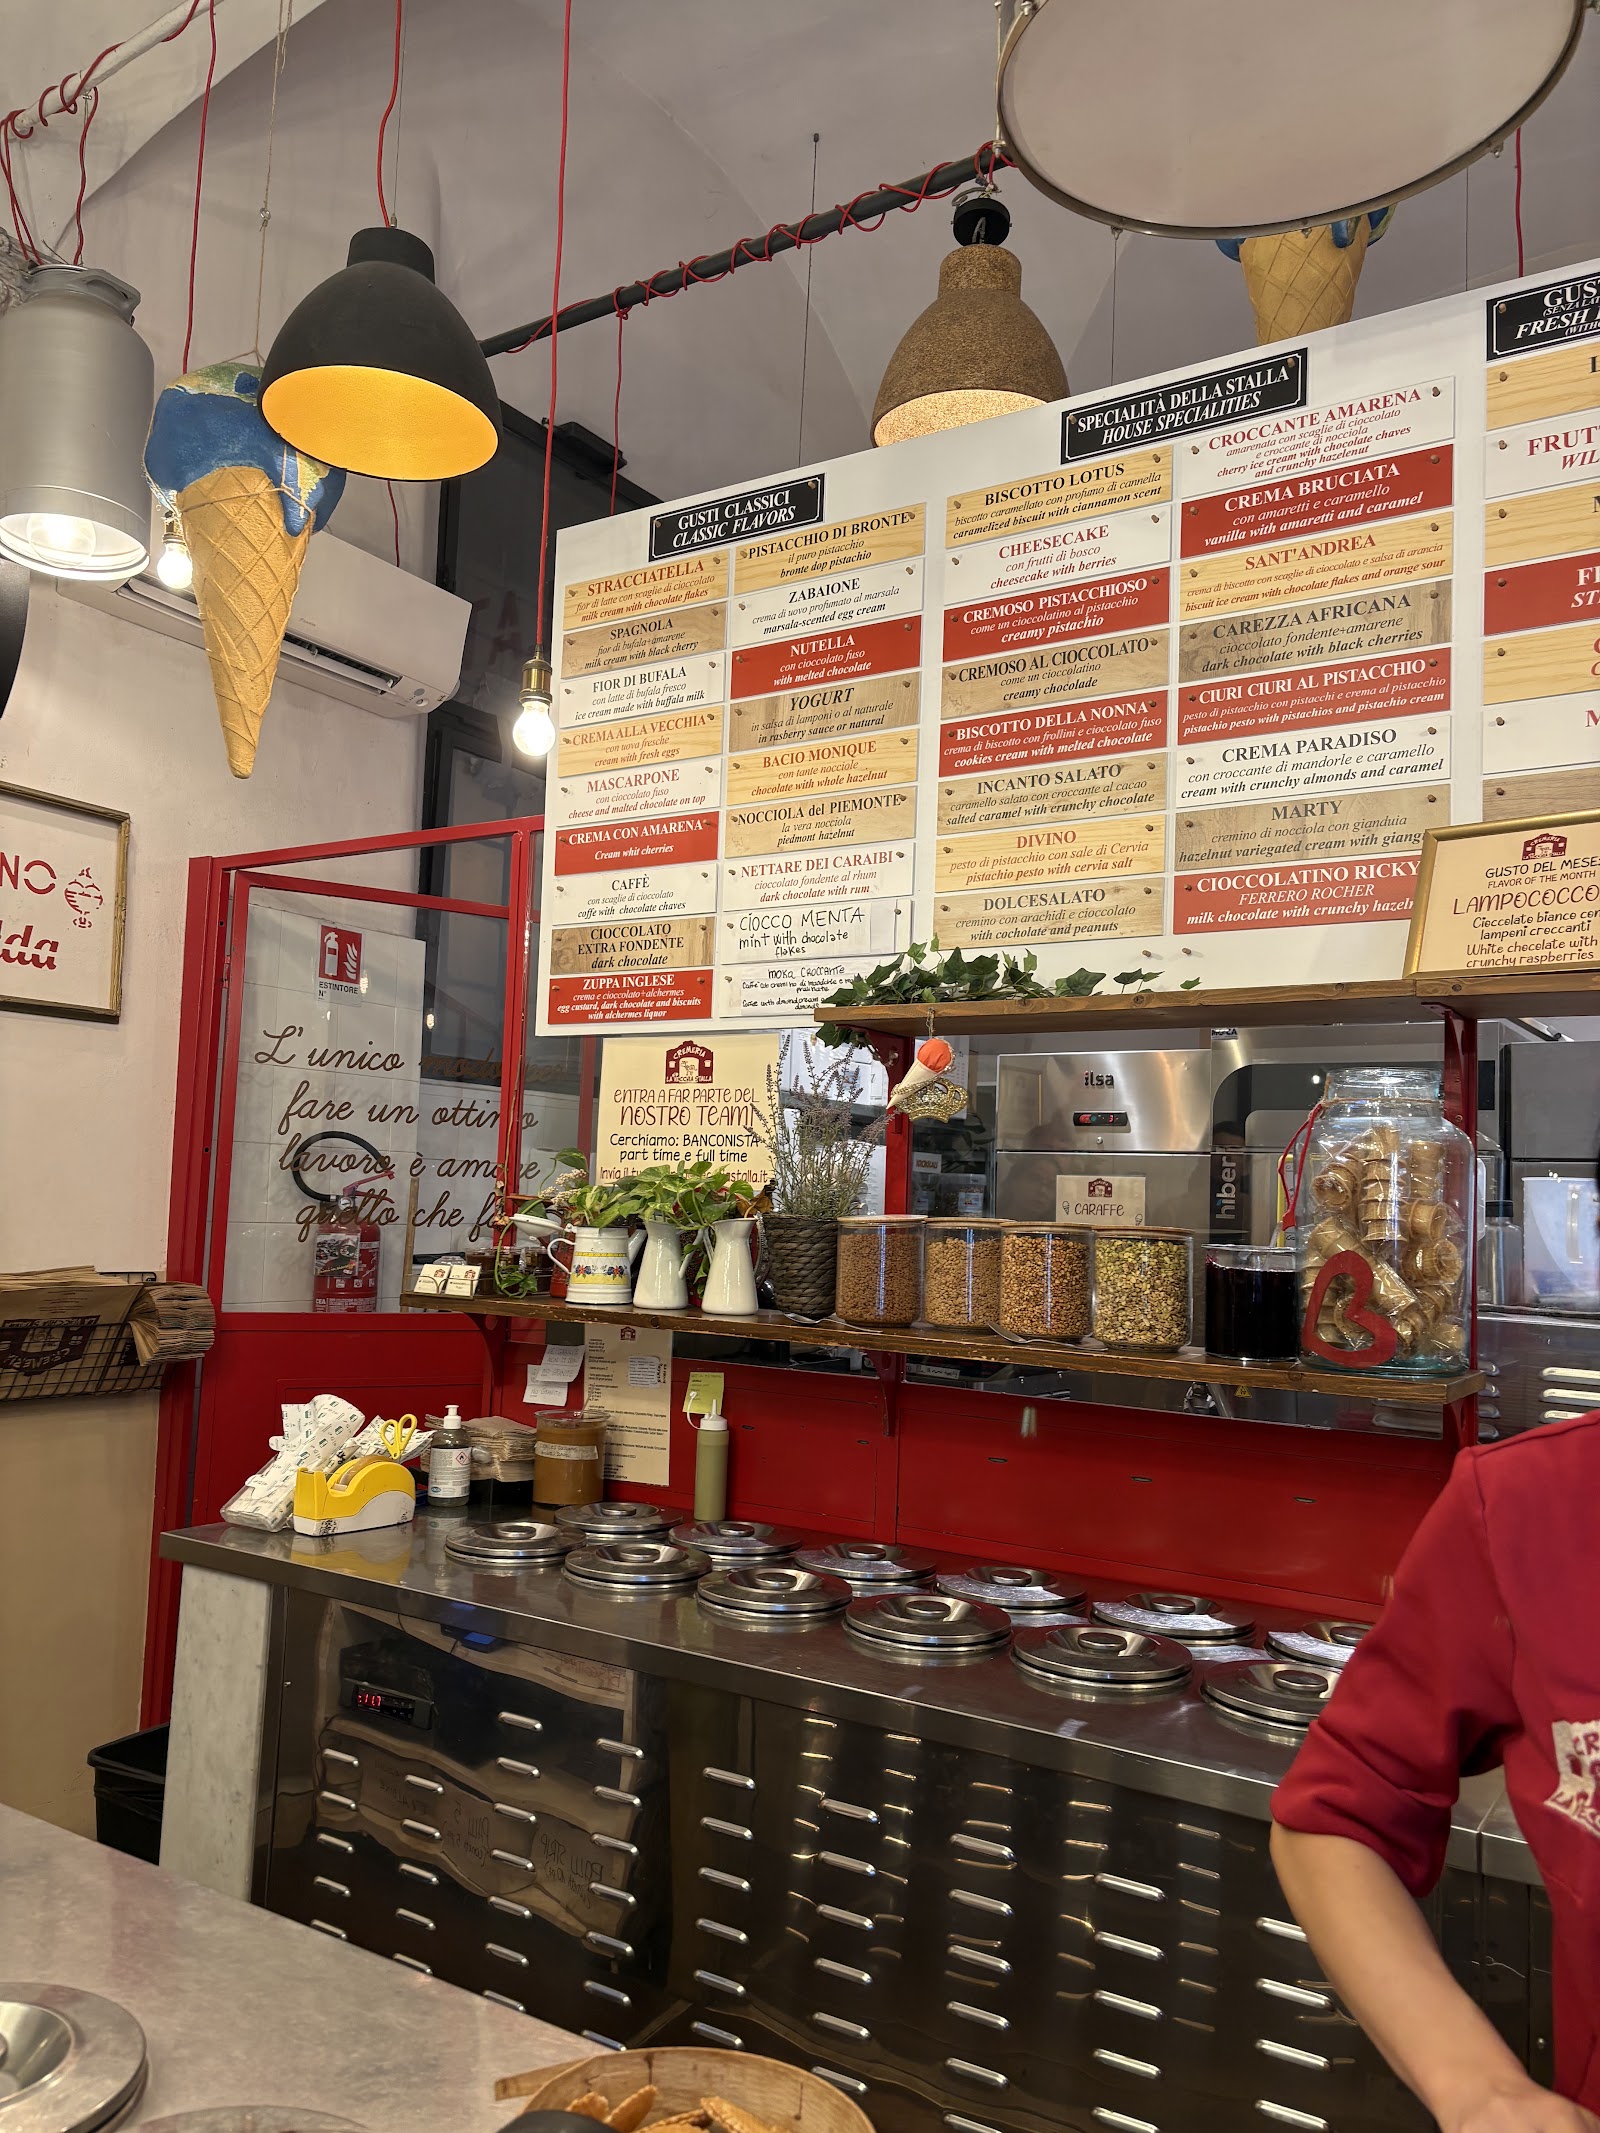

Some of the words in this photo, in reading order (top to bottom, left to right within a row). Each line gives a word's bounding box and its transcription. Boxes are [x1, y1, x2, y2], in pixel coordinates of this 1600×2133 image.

[1543, 280, 1600, 308] GUS
[1514, 308, 1591, 340] FRESH
[1565, 320, 1600, 336] (WITH
[1078, 392, 1165, 432] SPECIALITÀ
[1170, 383, 1222, 410] DELLA
[1226, 366, 1290, 396] STALLA
[1102, 418, 1154, 446] HOUSE
[1155, 391, 1262, 433] SPECIALITIES
[1208, 412, 1319, 449] CROCCANTE
[1324, 388, 1420, 422] AMARENA
[1527, 426, 1600, 456] FRUT
[985, 477, 1064, 505] BISCOTTO
[1069, 463, 1124, 486] LOTUS
[1224, 486, 1294, 511] CREMA
[1298, 462, 1400, 496] BRUCIATA
[678, 510, 721, 531] GUSTI
[724, 490, 790, 518] CLASSICI
[672, 520, 728, 548] CLASSIC
[731, 504, 796, 536] FLAVORS
[748, 530, 828, 559] PISTACCHIO
[832, 525, 846, 539] DI
[851, 511, 910, 535] BRONTE
[787, 552, 794, 563] il
[795, 551, 816, 564] puro
[817, 538, 864, 559] pistacchio
[998, 524, 1108, 558] CHEESECAKE
[1245, 534, 1376, 570] SANT'ANDREA
[587, 559, 703, 596] STRACCIATELLA
[780, 565, 808, 578] bronte
[810, 560, 827, 571] dop
[829, 550, 871, 569] pistachio
[788, 577, 859, 603] ZABAIONE
[963, 599, 1033, 623] CREMOSO
[1038, 578, 1147, 609] PISTACCHIOSO
[610, 618, 672, 639] SPAGNOLA
[1212, 612, 1302, 638] CAREZZA
[1306, 594, 1411, 623] AFRICANA
[790, 634, 854, 656] NUTELLA
[1201, 657, 1229, 672] dark
[1233, 650, 1292, 667] chocolate
[1296, 643, 1323, 657] with
[1328, 637, 1362, 652] black
[1367, 629, 1422, 646] cherries
[790, 687, 854, 711] YOGURT
[956, 718, 1031, 740] BISCOTTO
[1035, 710, 1087, 728] DELLA
[1090, 701, 1148, 720] NONNA
[762, 751, 804, 768] BACIO
[808, 740, 876, 761] MONIQUE
[1222, 742, 1291, 762] CREMA
[1296, 728, 1396, 753] PARADISO
[587, 768, 679, 792] MASCARPONE
[737, 806, 804, 825] NOCCIOLA
[808, 803, 824, 816] del
[830, 793, 903, 813] PIEMONTE
[1271, 800, 1342, 820] MARTY
[568, 830, 610, 844] CREMA
[612, 826, 638, 839] CON
[640, 819, 702, 836] AMARENA
[1016, 830, 1076, 848] DIVINO
[594, 850, 620, 860] Cream
[640, 843, 673, 855] cherries
[741, 860, 801, 877] NETTARE
[805, 857, 828, 871] DEI
[832, 850, 892, 868] CARAIBI
[611, 873, 649, 890] CAFFÈ
[1197, 866, 1348, 892] CIOCCOLATINO
[1354, 860, 1420, 879] RICKY
[1486, 864, 1528, 878] GUSTO
[1533, 861, 1556, 874] DEL
[1488, 878, 1522, 888] FLAVOR
[1524, 876, 1537, 884] OF
[1540, 874, 1557, 883] THE
[1560, 870, 1596, 880] MONTH
[983, 888, 1105, 910] DOLCESALATO
[1238, 888, 1307, 905] FERRERO
[1310, 883, 1374, 900] ROCHER
[1473, 916, 1534, 929] Cioccolato
[1537, 911, 1576, 923] bianco
[1480, 926, 1526, 942] lamponi
[1530, 920, 1590, 936] croccanti
[739, 932, 770, 949] mint
[773, 930, 796, 945] with
[801, 929, 848, 943] chocolate
[1466, 943, 1504, 956] White
[1507, 939, 1566, 953] chocolate
[1570, 936, 1598, 948] with
[1466, 954, 1516, 968] crunchy
[1520, 949, 1594, 966] raspberries
[318, 981, 358, 994] ESTINTORE
[582, 977, 620, 989] ZUPPA
[622, 974, 674, 987] INGLESE
[1084, 1070, 1114, 1087] ilsa
[278, 1080, 354, 1135] fare
[368, 1100, 420, 1125] un
[658, 1089, 666, 1103] A
[668, 1088, 690, 1103] FAR
[610, 1134, 679, 1147] Cerchiamo:
[683, 1134, 760, 1148] BANCONISTA
[278, 1133, 395, 1175] lavoro
[410, 1152, 426, 1178] è
[620, 1148, 648, 1162] part
[652, 1148, 680, 1161] time
[684, 1152, 692, 1161] e
[696, 1150, 715, 1162] full
[720, 1150, 748, 1162] time
[1216, 1156, 1236, 1220] hiber
[412, 1190, 464, 1228] che
